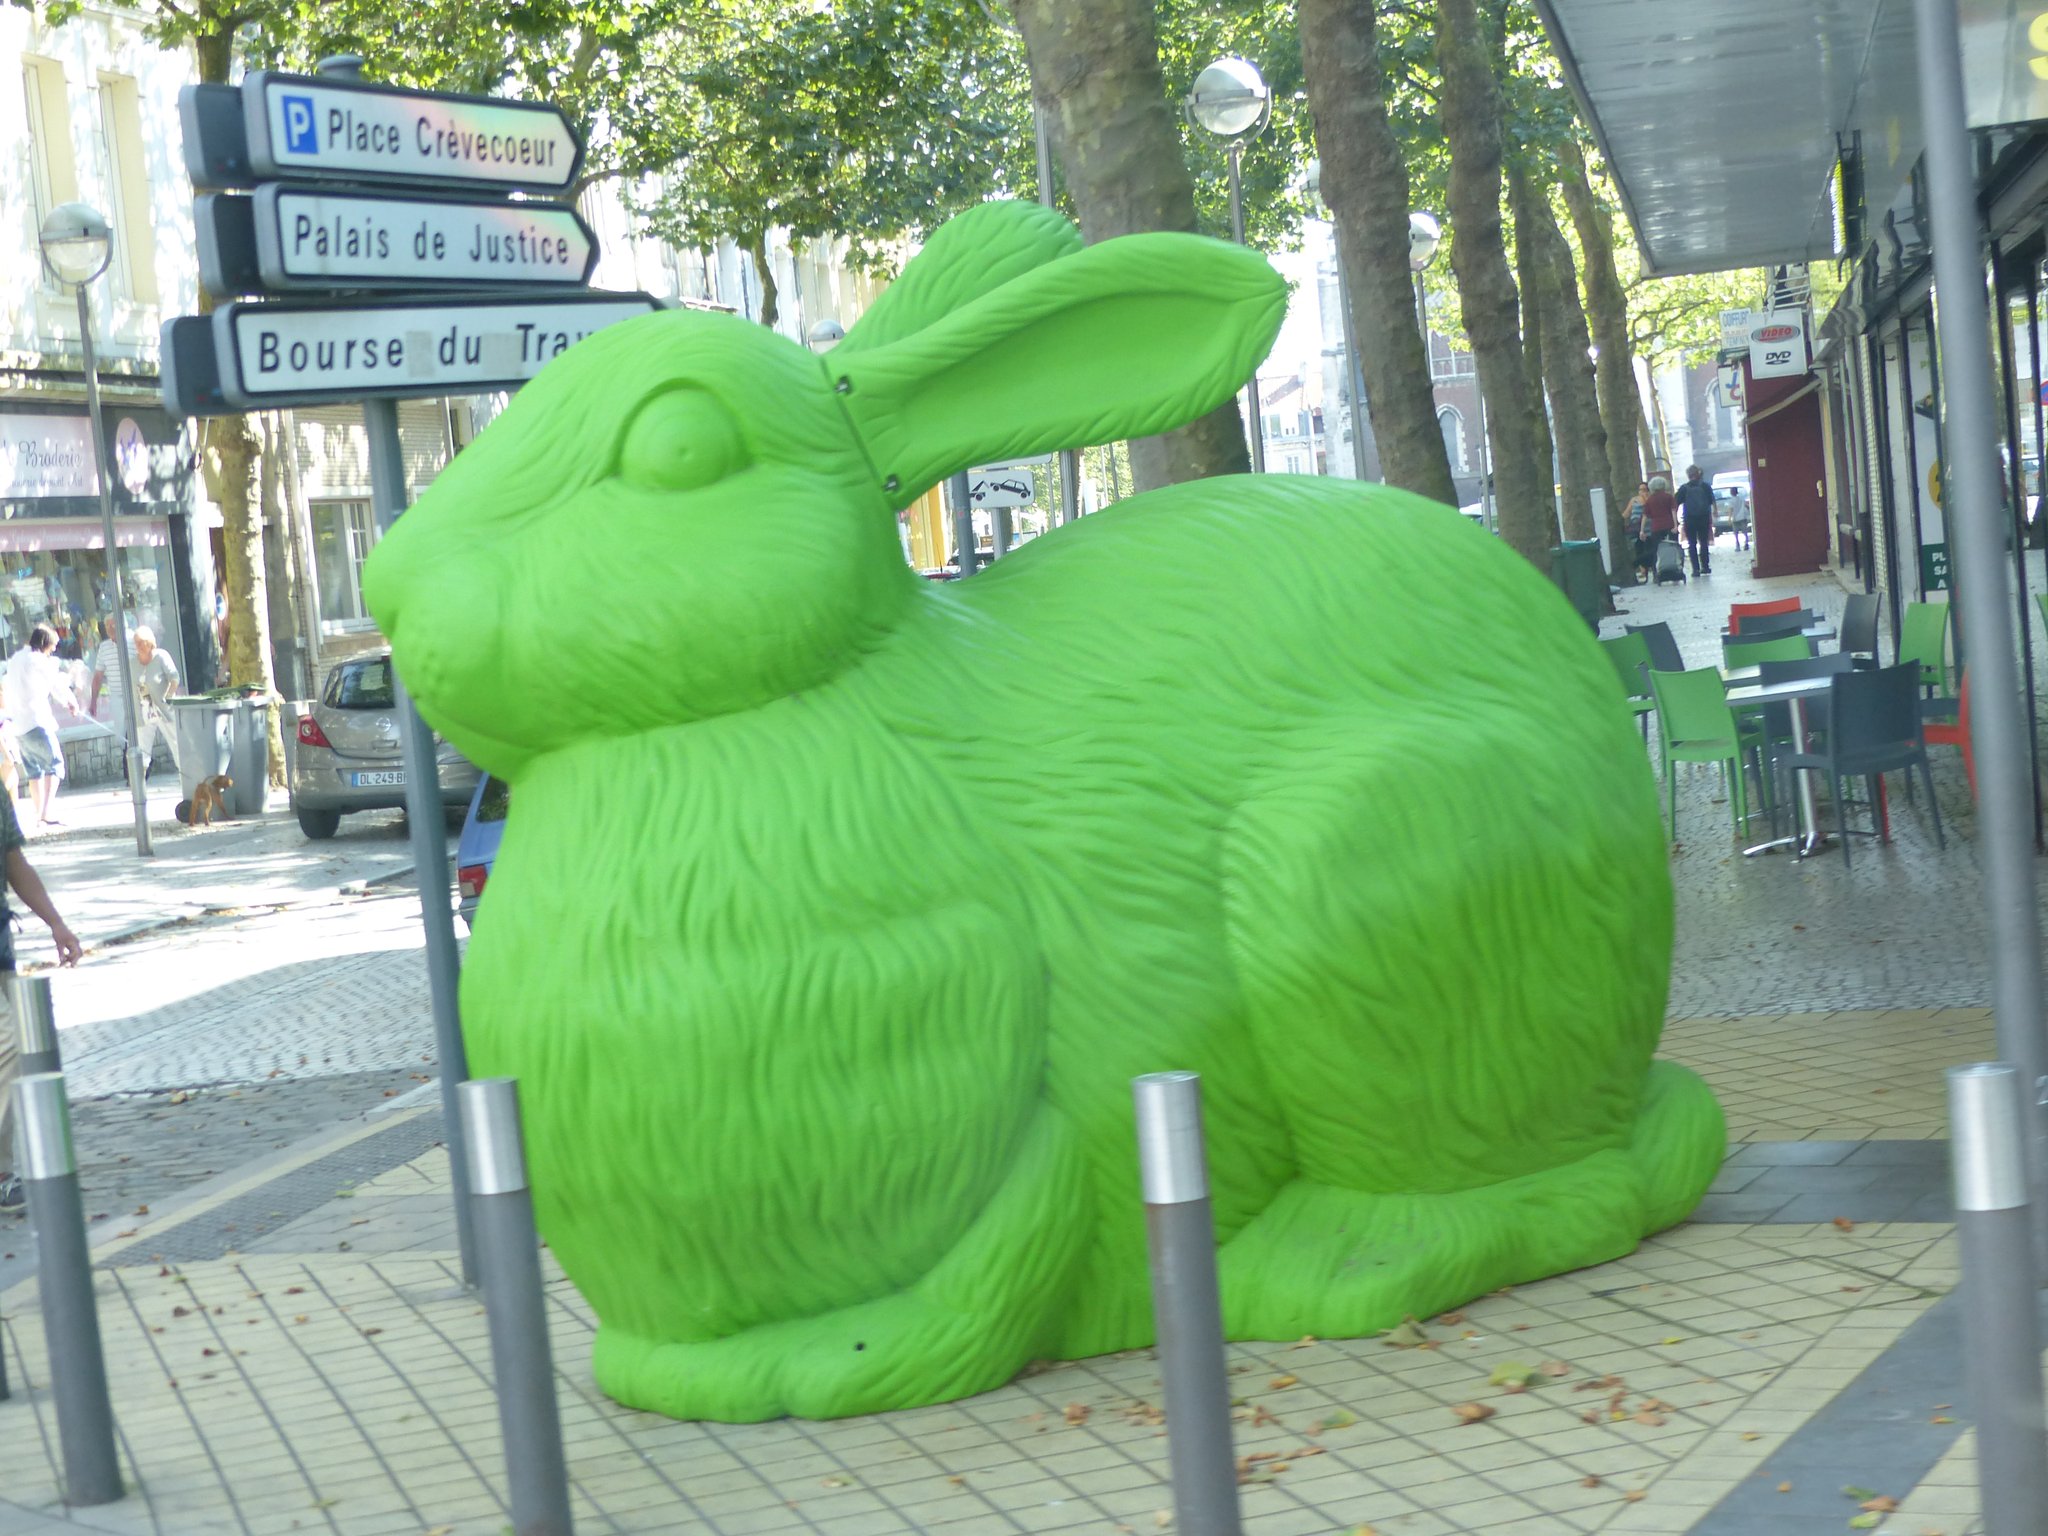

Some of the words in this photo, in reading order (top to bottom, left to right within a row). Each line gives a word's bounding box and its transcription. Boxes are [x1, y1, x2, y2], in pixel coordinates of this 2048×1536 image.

[288, 101, 311, 148] P
[328, 108, 400, 154] Place
[416, 115, 557, 167] Crèvecoeur
[294, 214, 389, 259] Palais
[414, 220, 445, 261] de
[469, 223, 569, 265] Justice
[259, 331, 404, 374] Bourse
[438, 325, 481, 366] du
[516, 323, 593, 363] Tra
[1760, 327, 1793, 338] VIDEO
[1765, 351, 1791, 361] DVD
